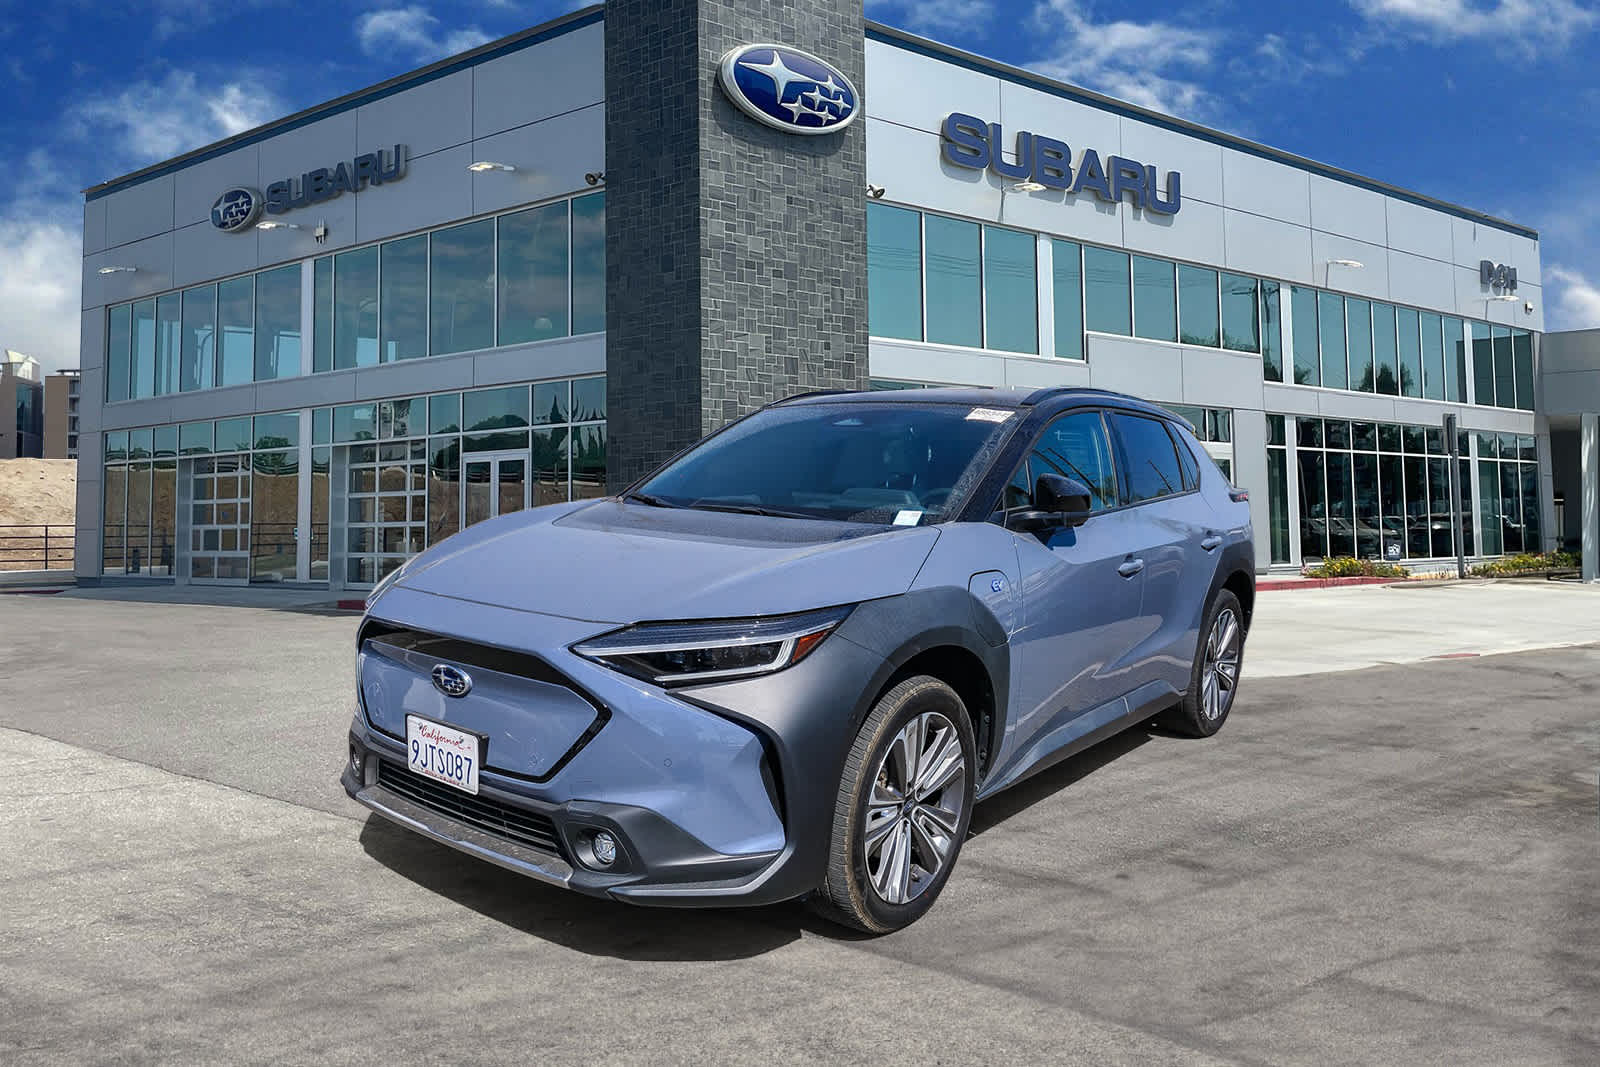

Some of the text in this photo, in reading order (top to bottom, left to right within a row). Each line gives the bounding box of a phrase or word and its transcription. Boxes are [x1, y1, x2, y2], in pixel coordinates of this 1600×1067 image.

[266, 144, 406, 214] SUBARU
[942, 112, 1181, 215] SUBARU
[412, 739, 472, 785] 9JTS087
[421, 725, 463, 748] California
